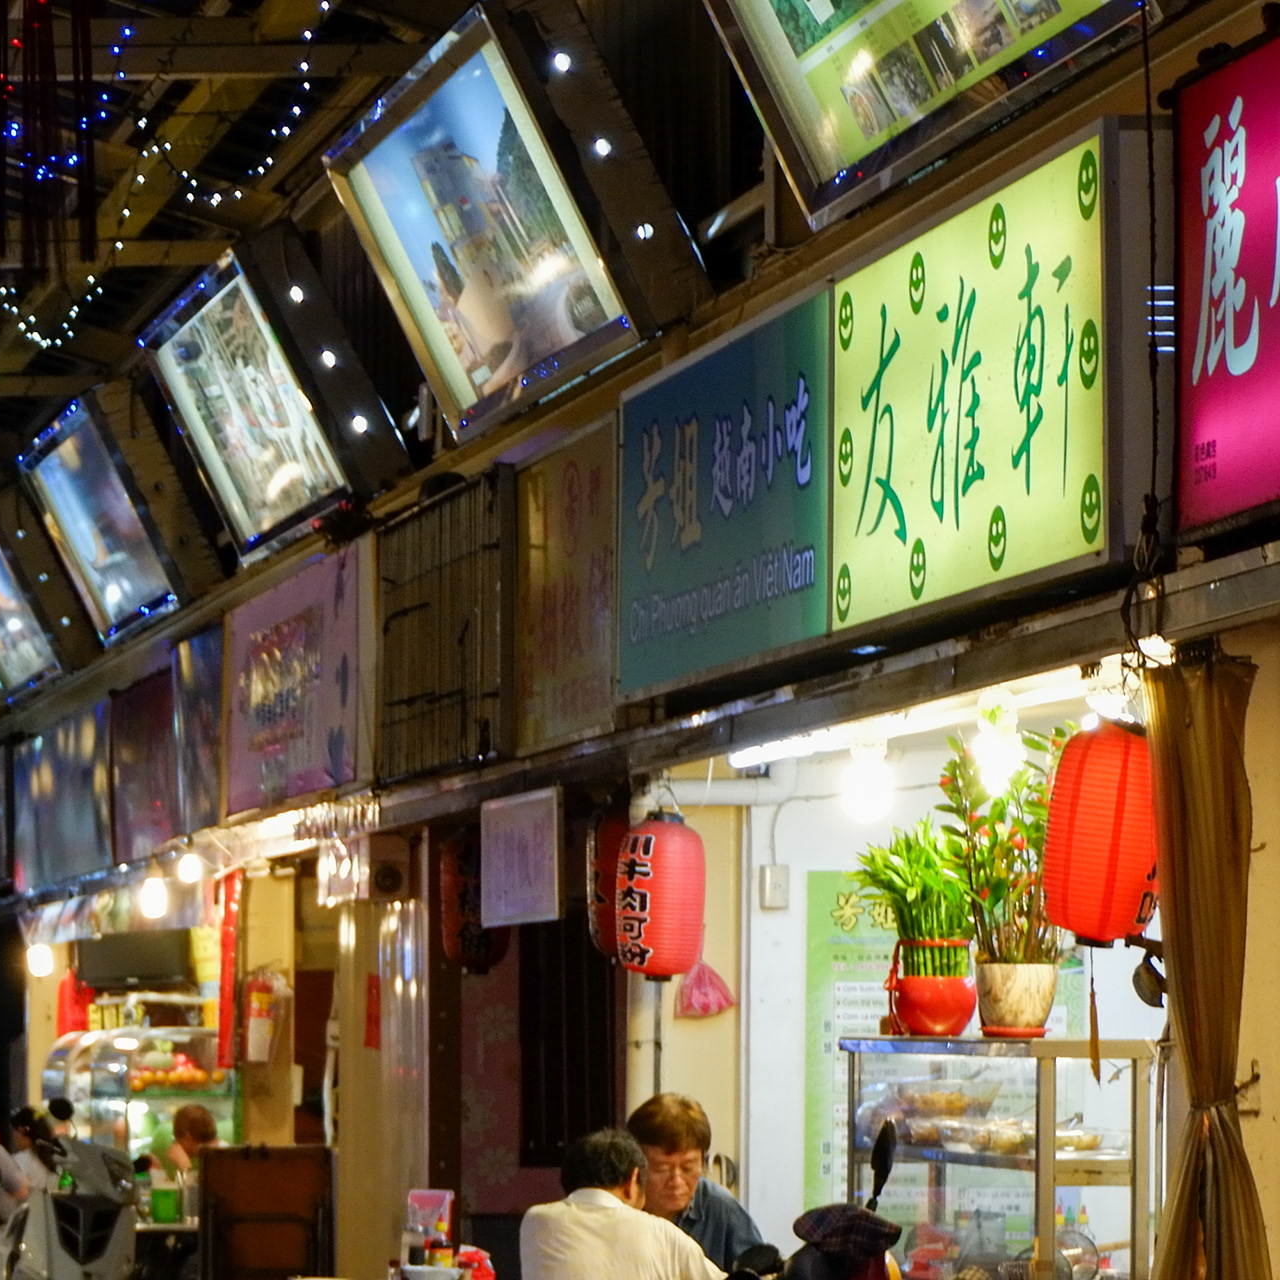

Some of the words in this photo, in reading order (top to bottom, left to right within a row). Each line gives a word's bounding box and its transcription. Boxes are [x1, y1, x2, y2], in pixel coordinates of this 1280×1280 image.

[1192, 95, 1280, 388] 麗
[855, 243, 1073, 546] 友雅軒
[782, 544, 816, 592] Nam
